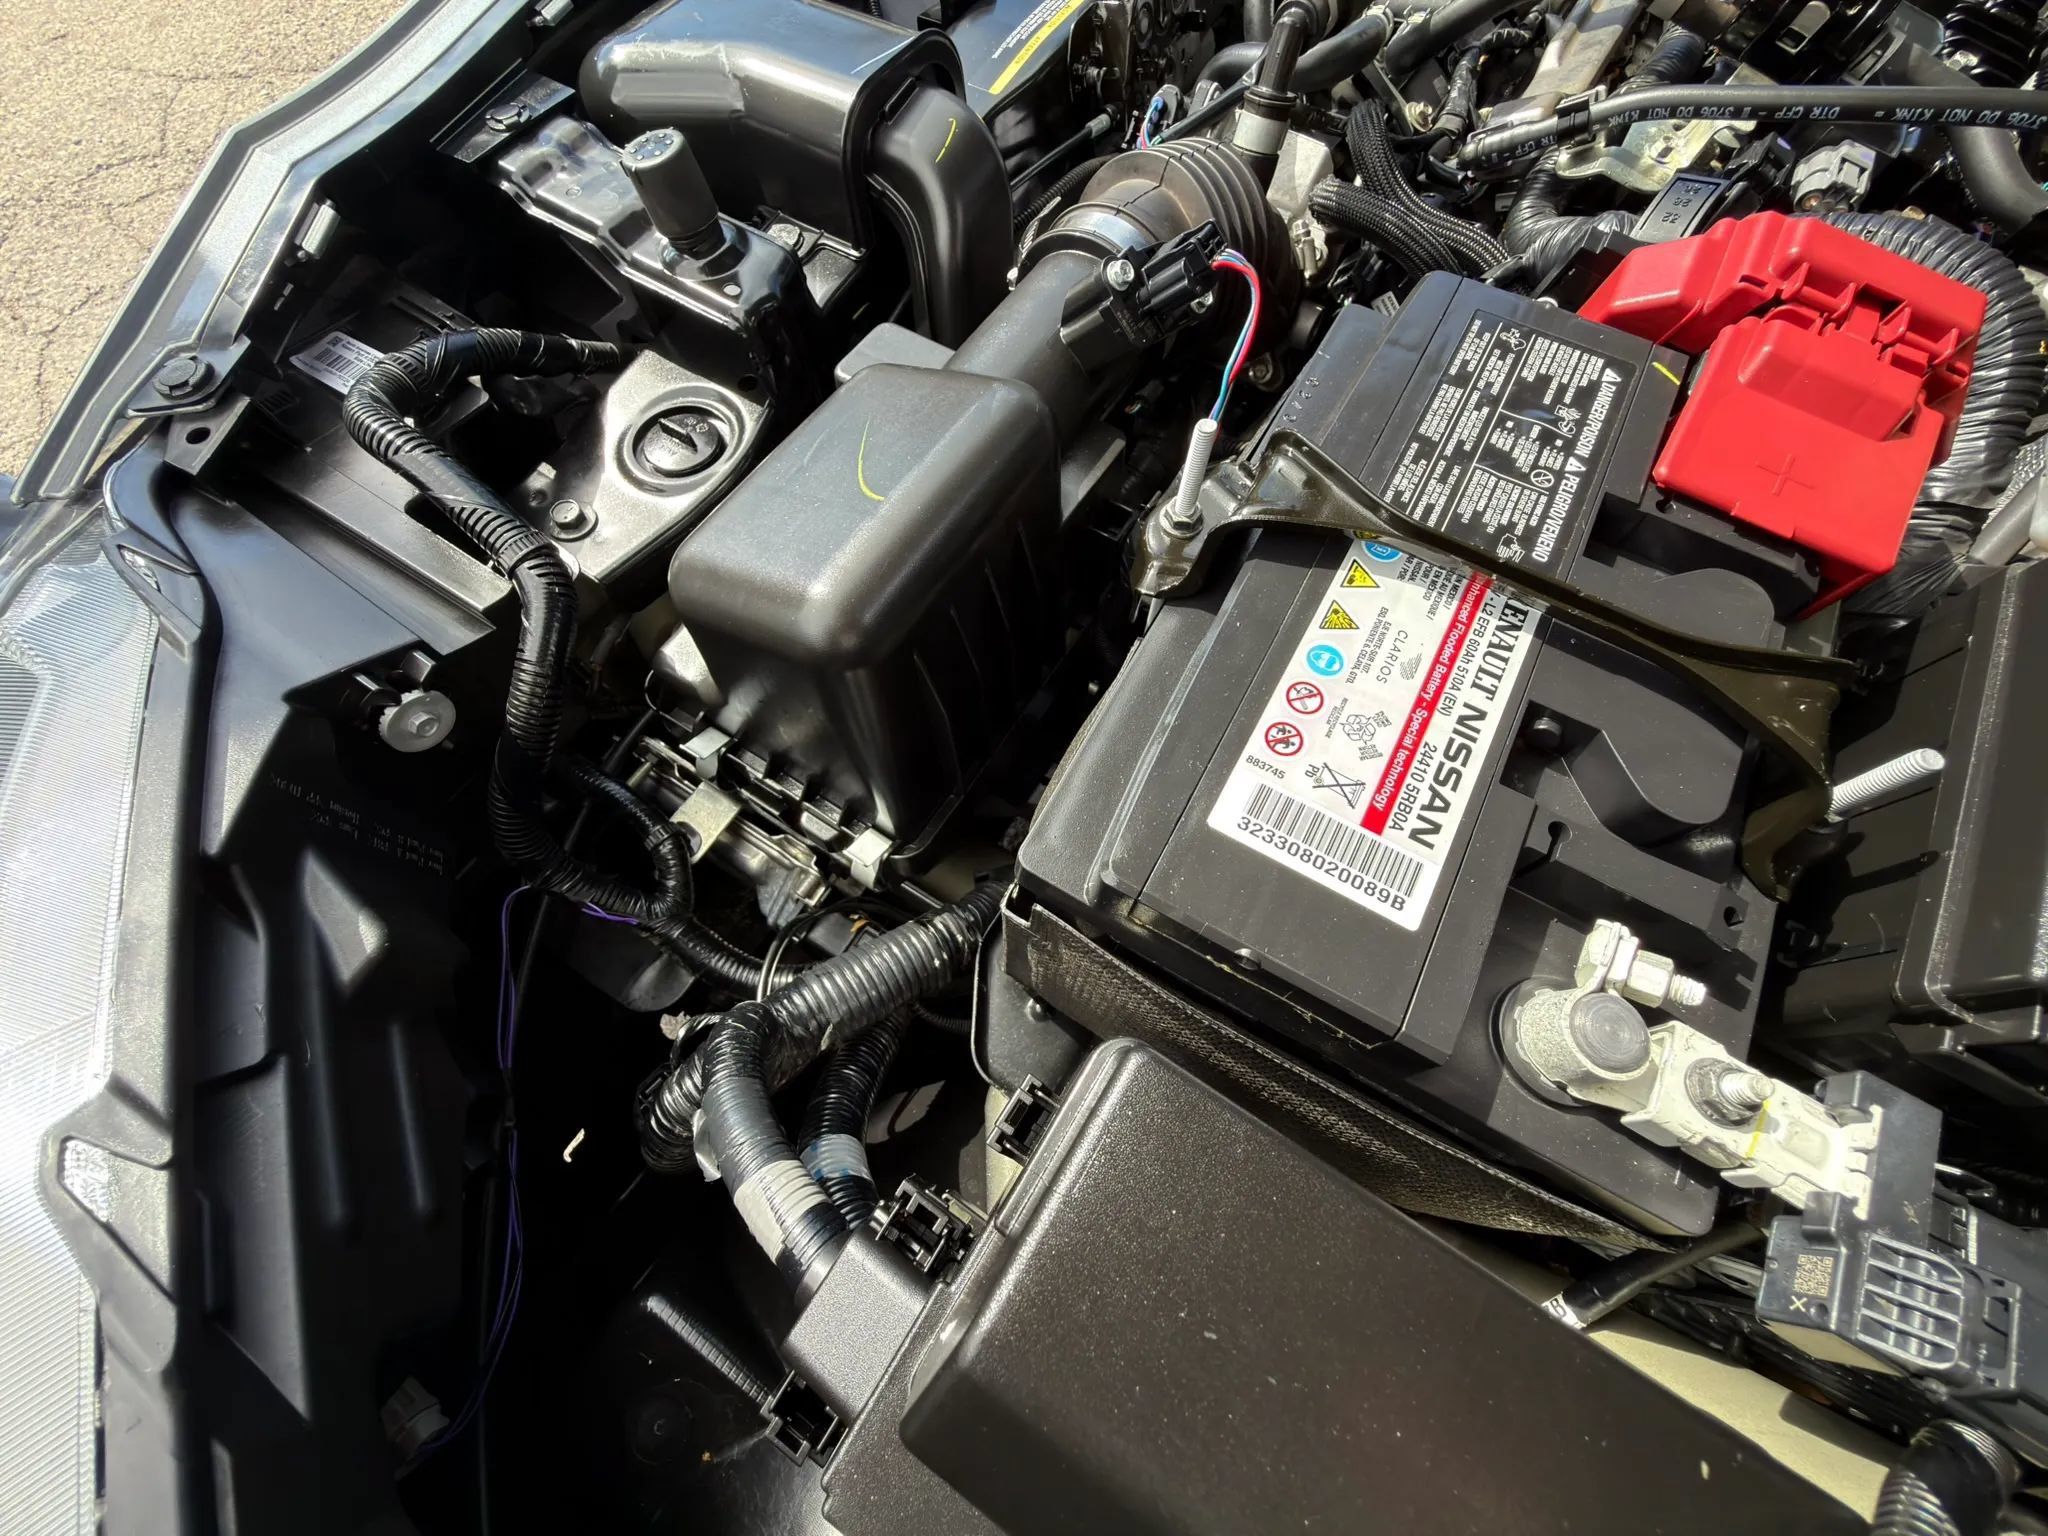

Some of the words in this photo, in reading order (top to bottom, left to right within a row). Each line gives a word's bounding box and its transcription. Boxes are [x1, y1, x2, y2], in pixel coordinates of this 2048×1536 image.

[1646, 106, 1670, 118] NOT
[1676, 106, 1694, 118] DO
[1699, 105, 1734, 118] 3706
[1773, 103, 1804, 119] CFP
[1808, 104, 1840, 120] DTR
[1890, 105, 1934, 123] KINK
[1938, 108, 1973, 125] NOT
[1980, 110, 2002, 127] DO
[2007, 111, 2047, 130] 3706
[1573, 381, 1616, 458] DANGER/POISON
[1530, 472, 1580, 563] PELIGRO/VENENO
[1456, 581, 1482, 623] nhanced
[1480, 601, 1497, 617] L2
[1364, 617, 1383, 644] PONIENTE
[1380, 620, 1392, 631] EJE
[1471, 615, 1491, 639] EFB
[1365, 629, 1387, 663] NORTE-SUR
[1374, 628, 1409, 684] CLARIOS
[1438, 621, 1466, 664] Flooded
[1459, 637, 1481, 666] 60Ah
[1467, 595, 1531, 701] ENAULT
[1419, 663, 1447, 702] Battery
[1447, 664, 1469, 693] 510A
[1434, 691, 1459, 718] (EN)
[1400, 705, 1428, 749] Special
[1245, 754, 1287, 780] 883745
[1304, 763, 1320, 779] Pb
[1405, 700, 1489, 851] NISSAN
[1408, 740, 1438, 784] 24410
[1370, 747, 1411, 812] technology
[1235, 814, 1407, 912] 323308020089B
